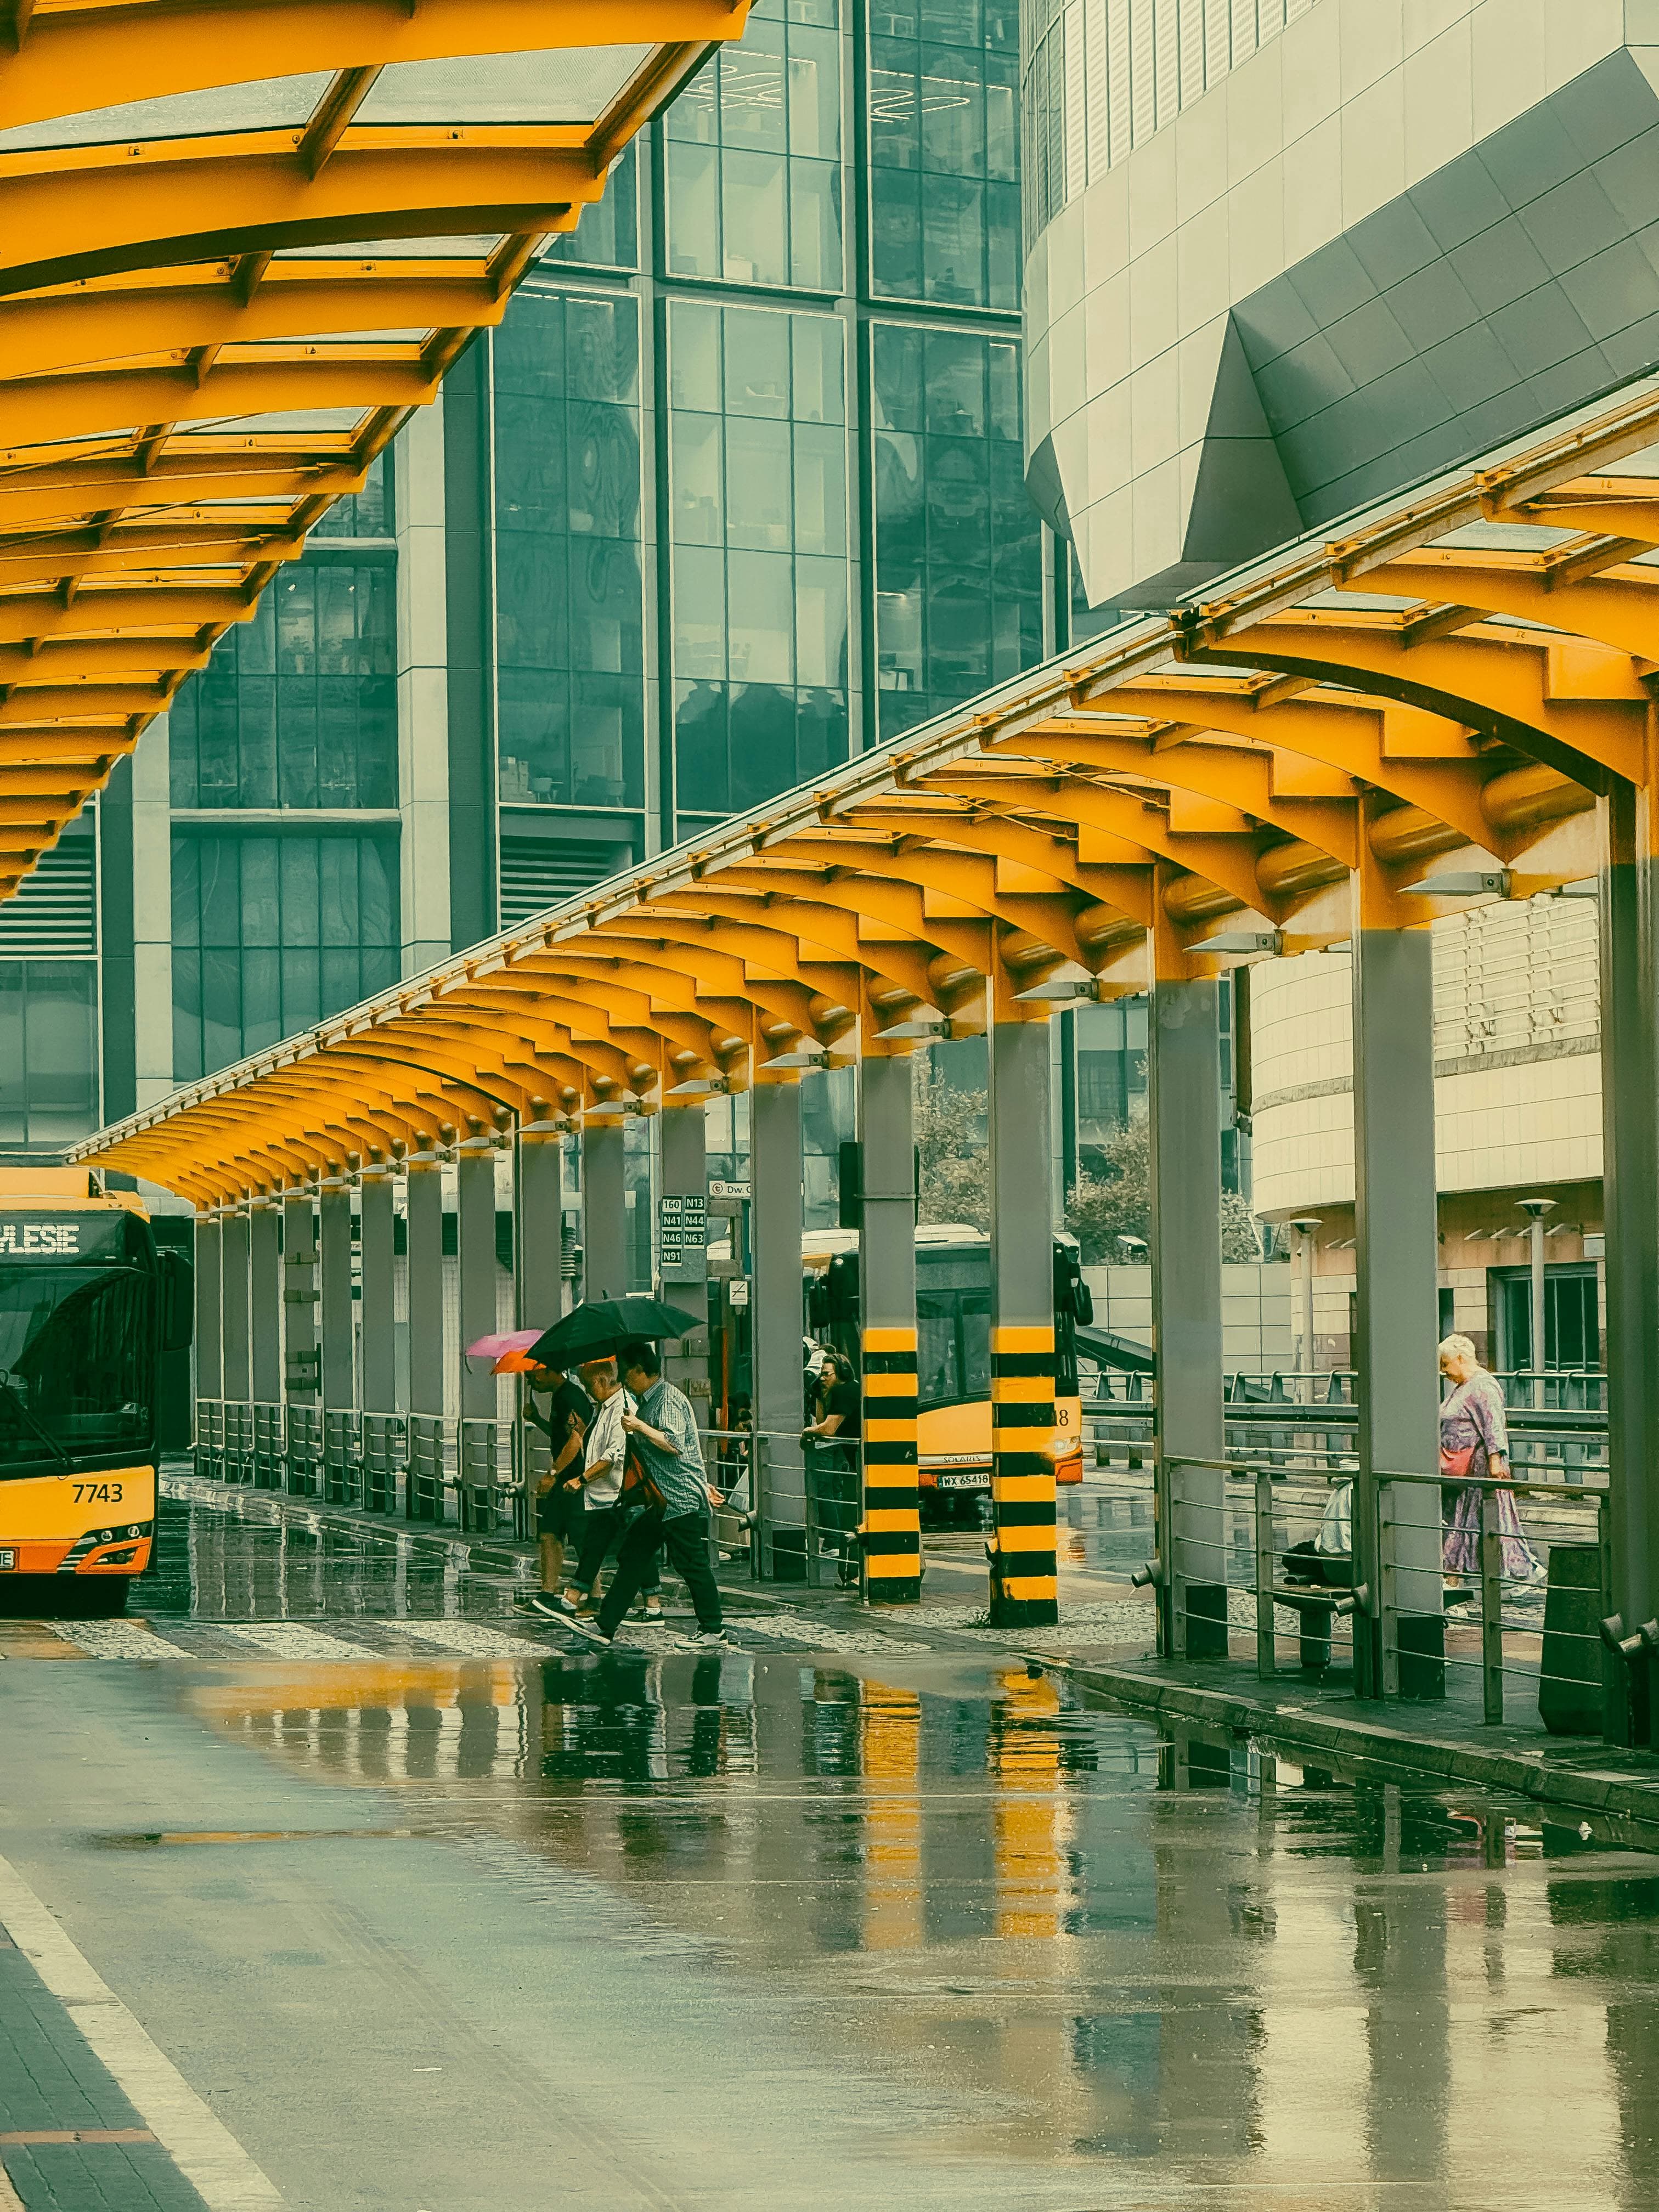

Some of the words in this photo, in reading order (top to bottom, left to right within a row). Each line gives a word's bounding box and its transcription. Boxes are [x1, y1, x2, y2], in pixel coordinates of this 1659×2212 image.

[727, 1186, 744, 1194] Dw.
[664, 1200, 680, 1209] 160
[686, 1198, 703, 1207] N13
[663, 1216, 680, 1225] N41
[686, 1216, 704, 1225] N44
[663, 1233, 681, 1243] N46
[685, 1234, 703, 1243] N63
[663, 1251, 680, 1261] N91
[944, 1476, 957, 1486] WX
[72, 1483, 123, 1503] 7743
